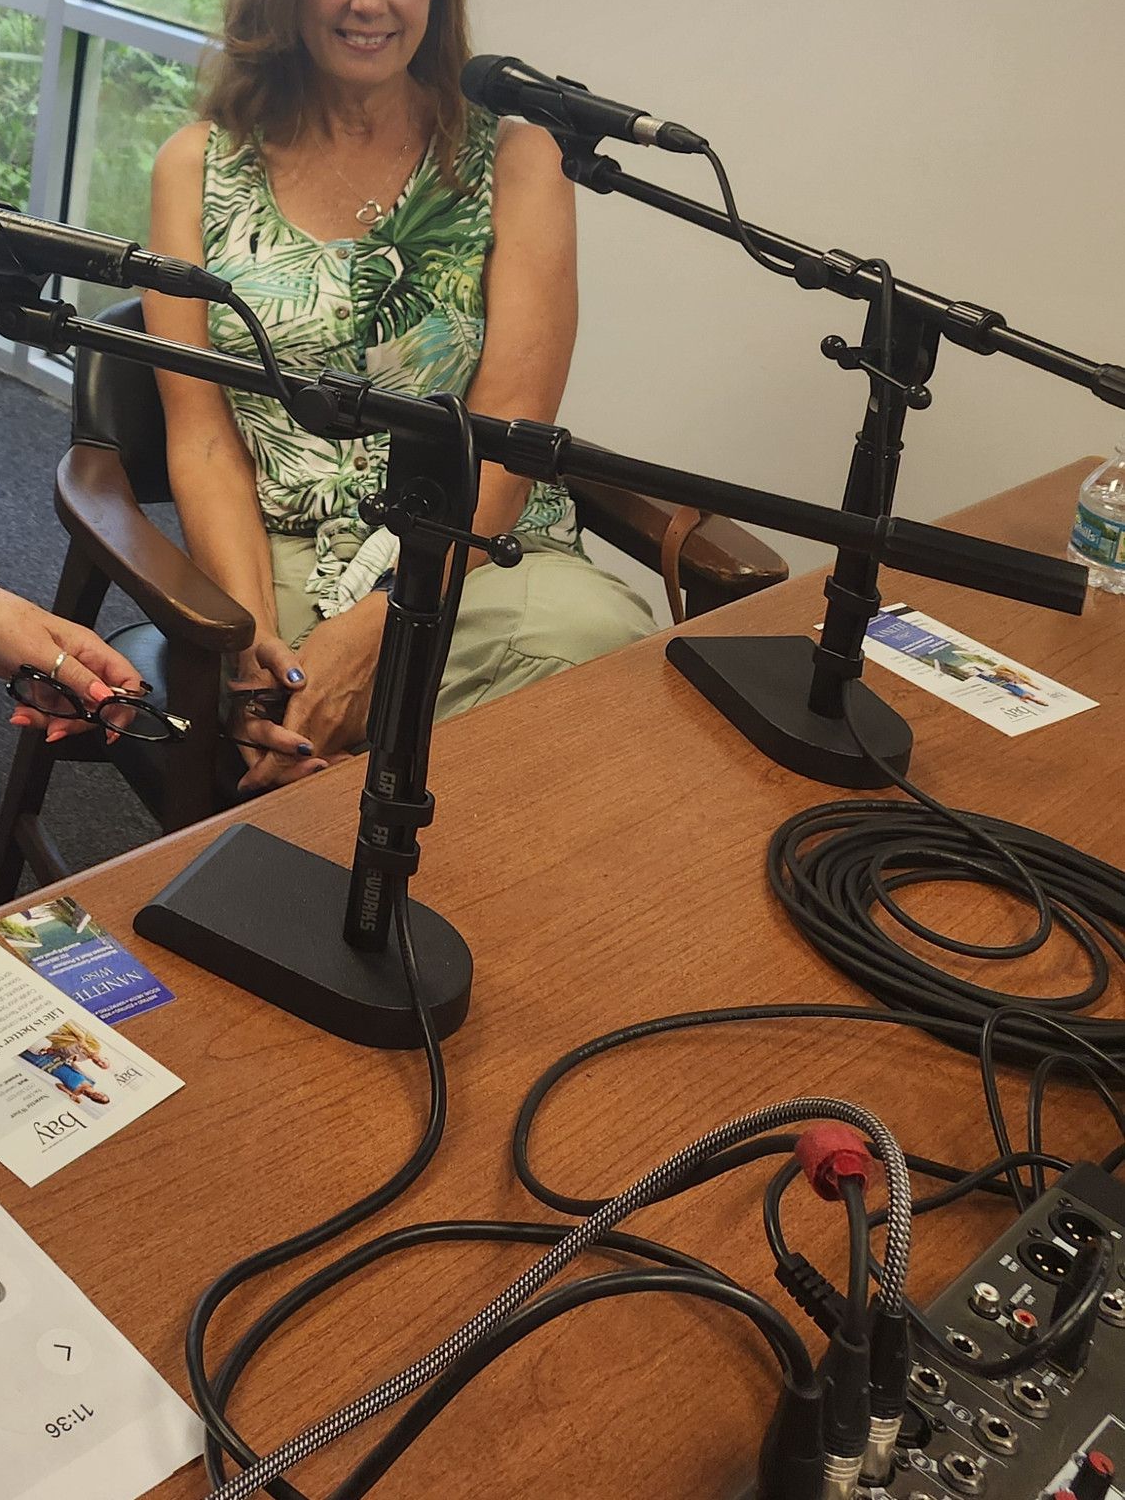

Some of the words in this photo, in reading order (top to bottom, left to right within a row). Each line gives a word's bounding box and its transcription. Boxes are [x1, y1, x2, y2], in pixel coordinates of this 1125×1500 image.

[74, 970, 143, 1002] NANETTE
[78, 966, 114, 983] Wiser
[31, 1018, 46, 1029] is
[40, 1007, 64, 1023] Life
[0, 1023, 37, 1047] better
[113, 1062, 142, 1089] bay
[33, 1110, 87, 1146] bay
[43, 1401, 95, 1439] 11:36
